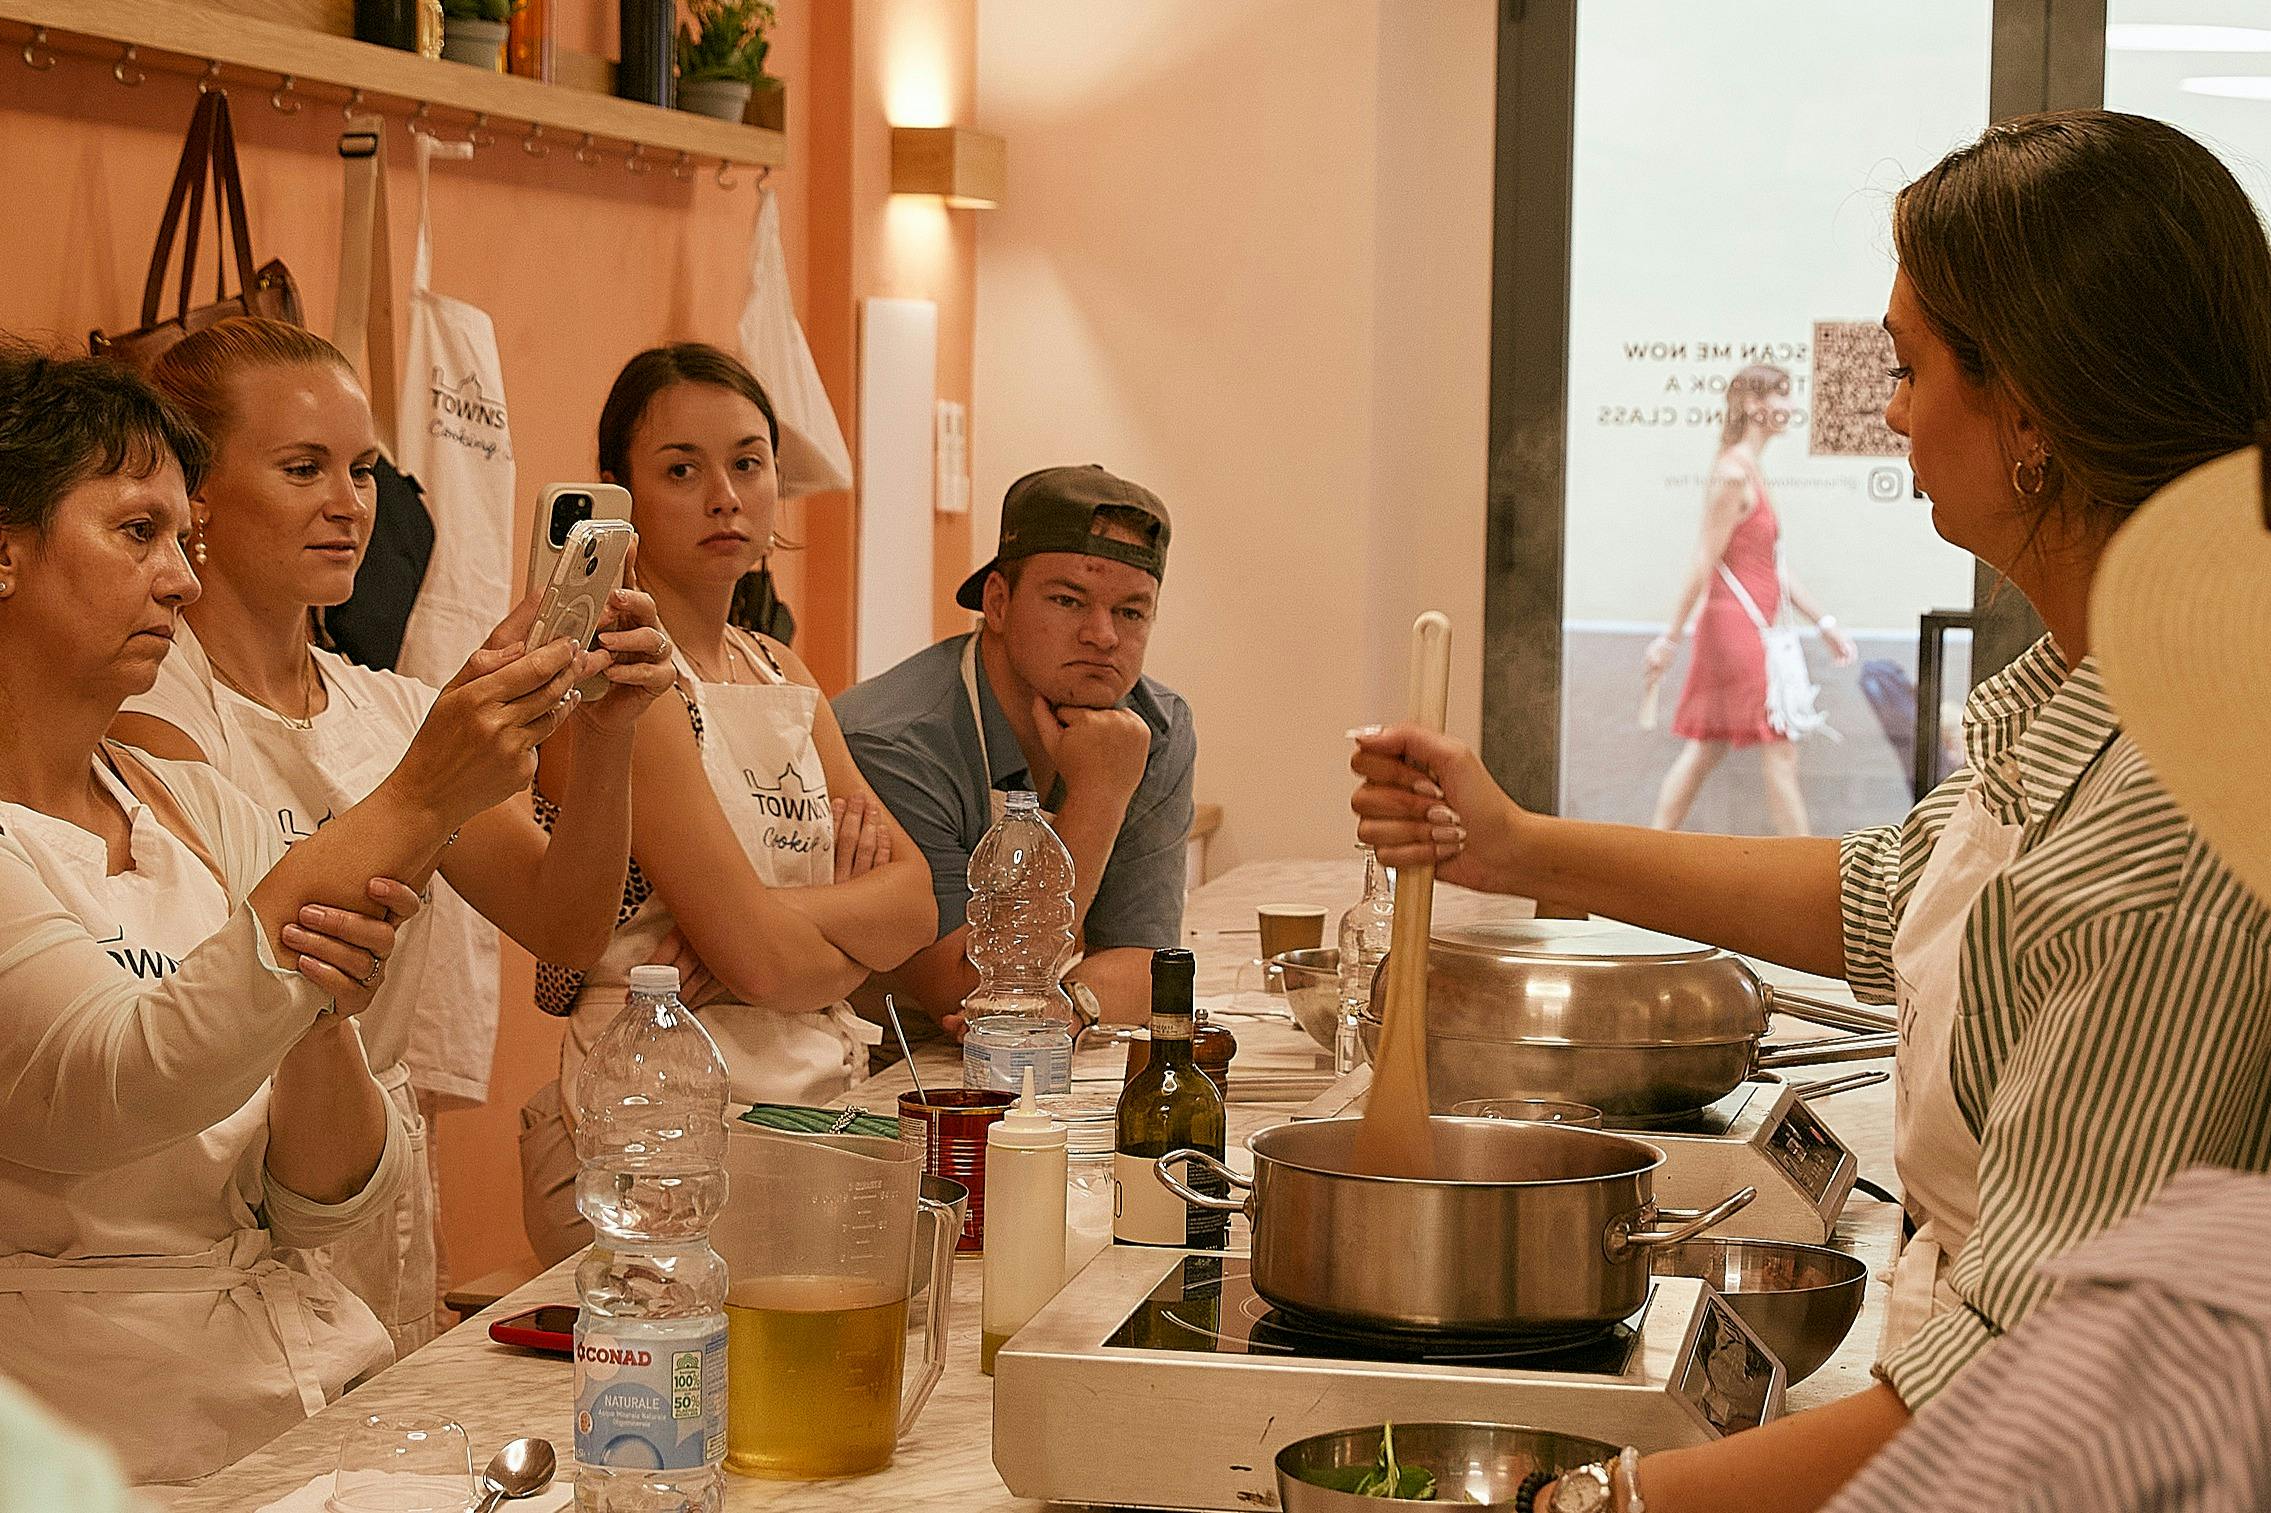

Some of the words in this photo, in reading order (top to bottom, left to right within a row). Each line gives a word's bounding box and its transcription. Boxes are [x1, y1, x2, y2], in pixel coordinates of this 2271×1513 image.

[432, 388, 506, 429] TOWNS
[586, 1347, 652, 1367] CONAD
[674, 1373, 700, 1388] 100%
[604, 1394, 661, 1410] NATURALE
[674, 1395, 700, 1409] 50%
